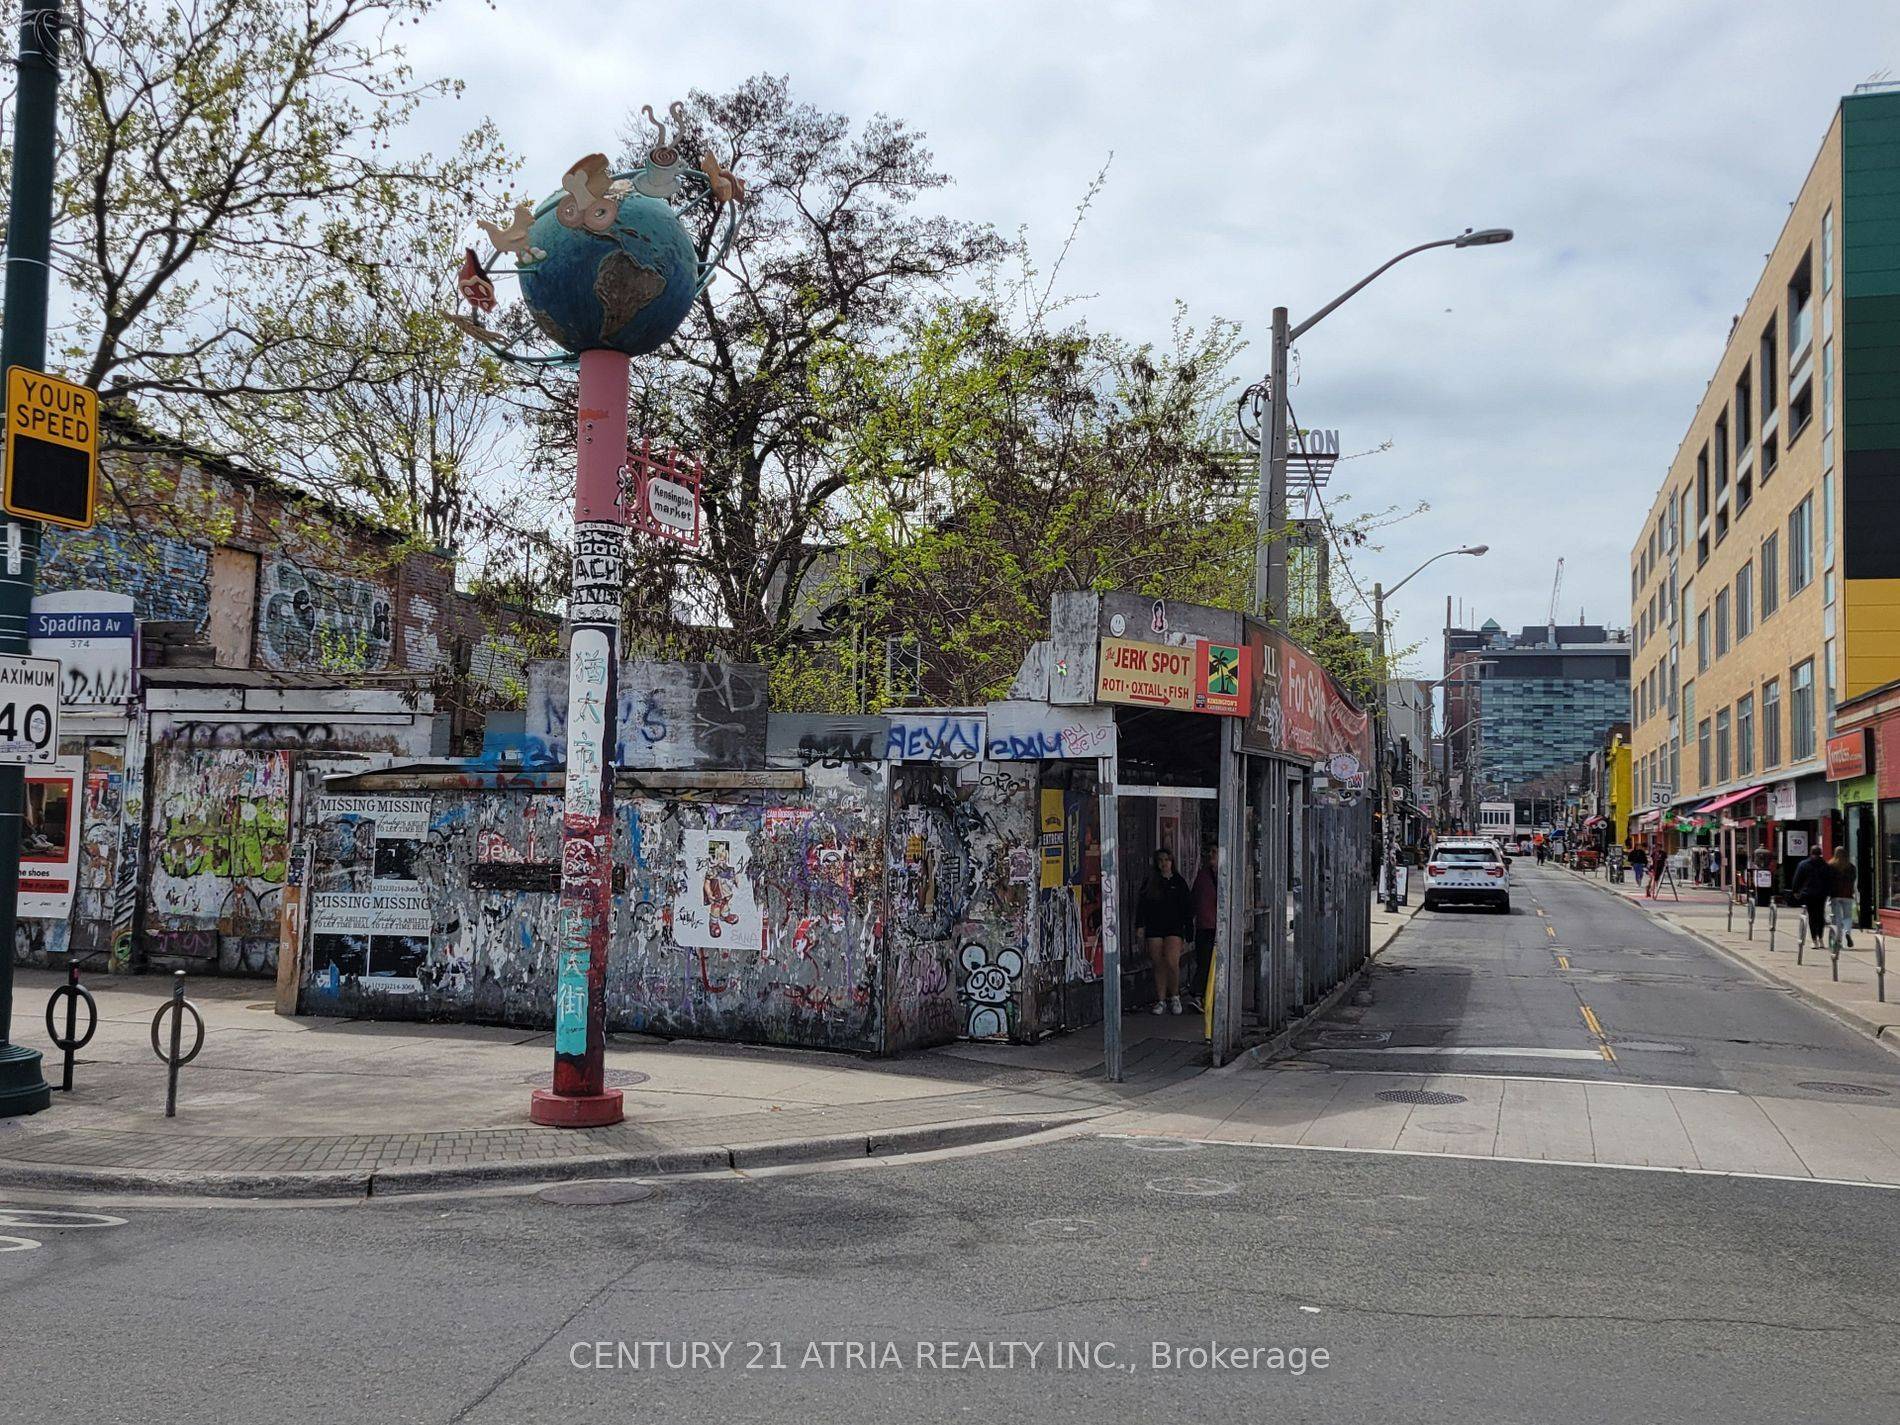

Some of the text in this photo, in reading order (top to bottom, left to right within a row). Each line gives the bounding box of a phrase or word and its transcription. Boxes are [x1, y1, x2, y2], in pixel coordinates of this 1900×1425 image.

[22, 377, 86, 417] YOUR
[16, 404, 89, 443] SPEED
[654, 484, 693, 508] Kensington
[654, 501, 692, 521] market
[39, 615, 121, 636] Spadina Av
[69, 640, 91, 649] 374
[1114, 647, 1148, 671] JERK
[1151, 652, 1191, 676] SPOT
[0, 667, 55, 687] AXIMUM
[1288, 656, 1307, 714] For
[1102, 678, 1189, 700] ROTI OXTAIL FISH
[0, 702, 52, 750] 40
[319, 798, 431, 813] MISSING MISSING
[1652, 792, 1670, 805] 30
[28, 867, 50, 877] shoes
[314, 895, 430, 911] MISSING MISSING
